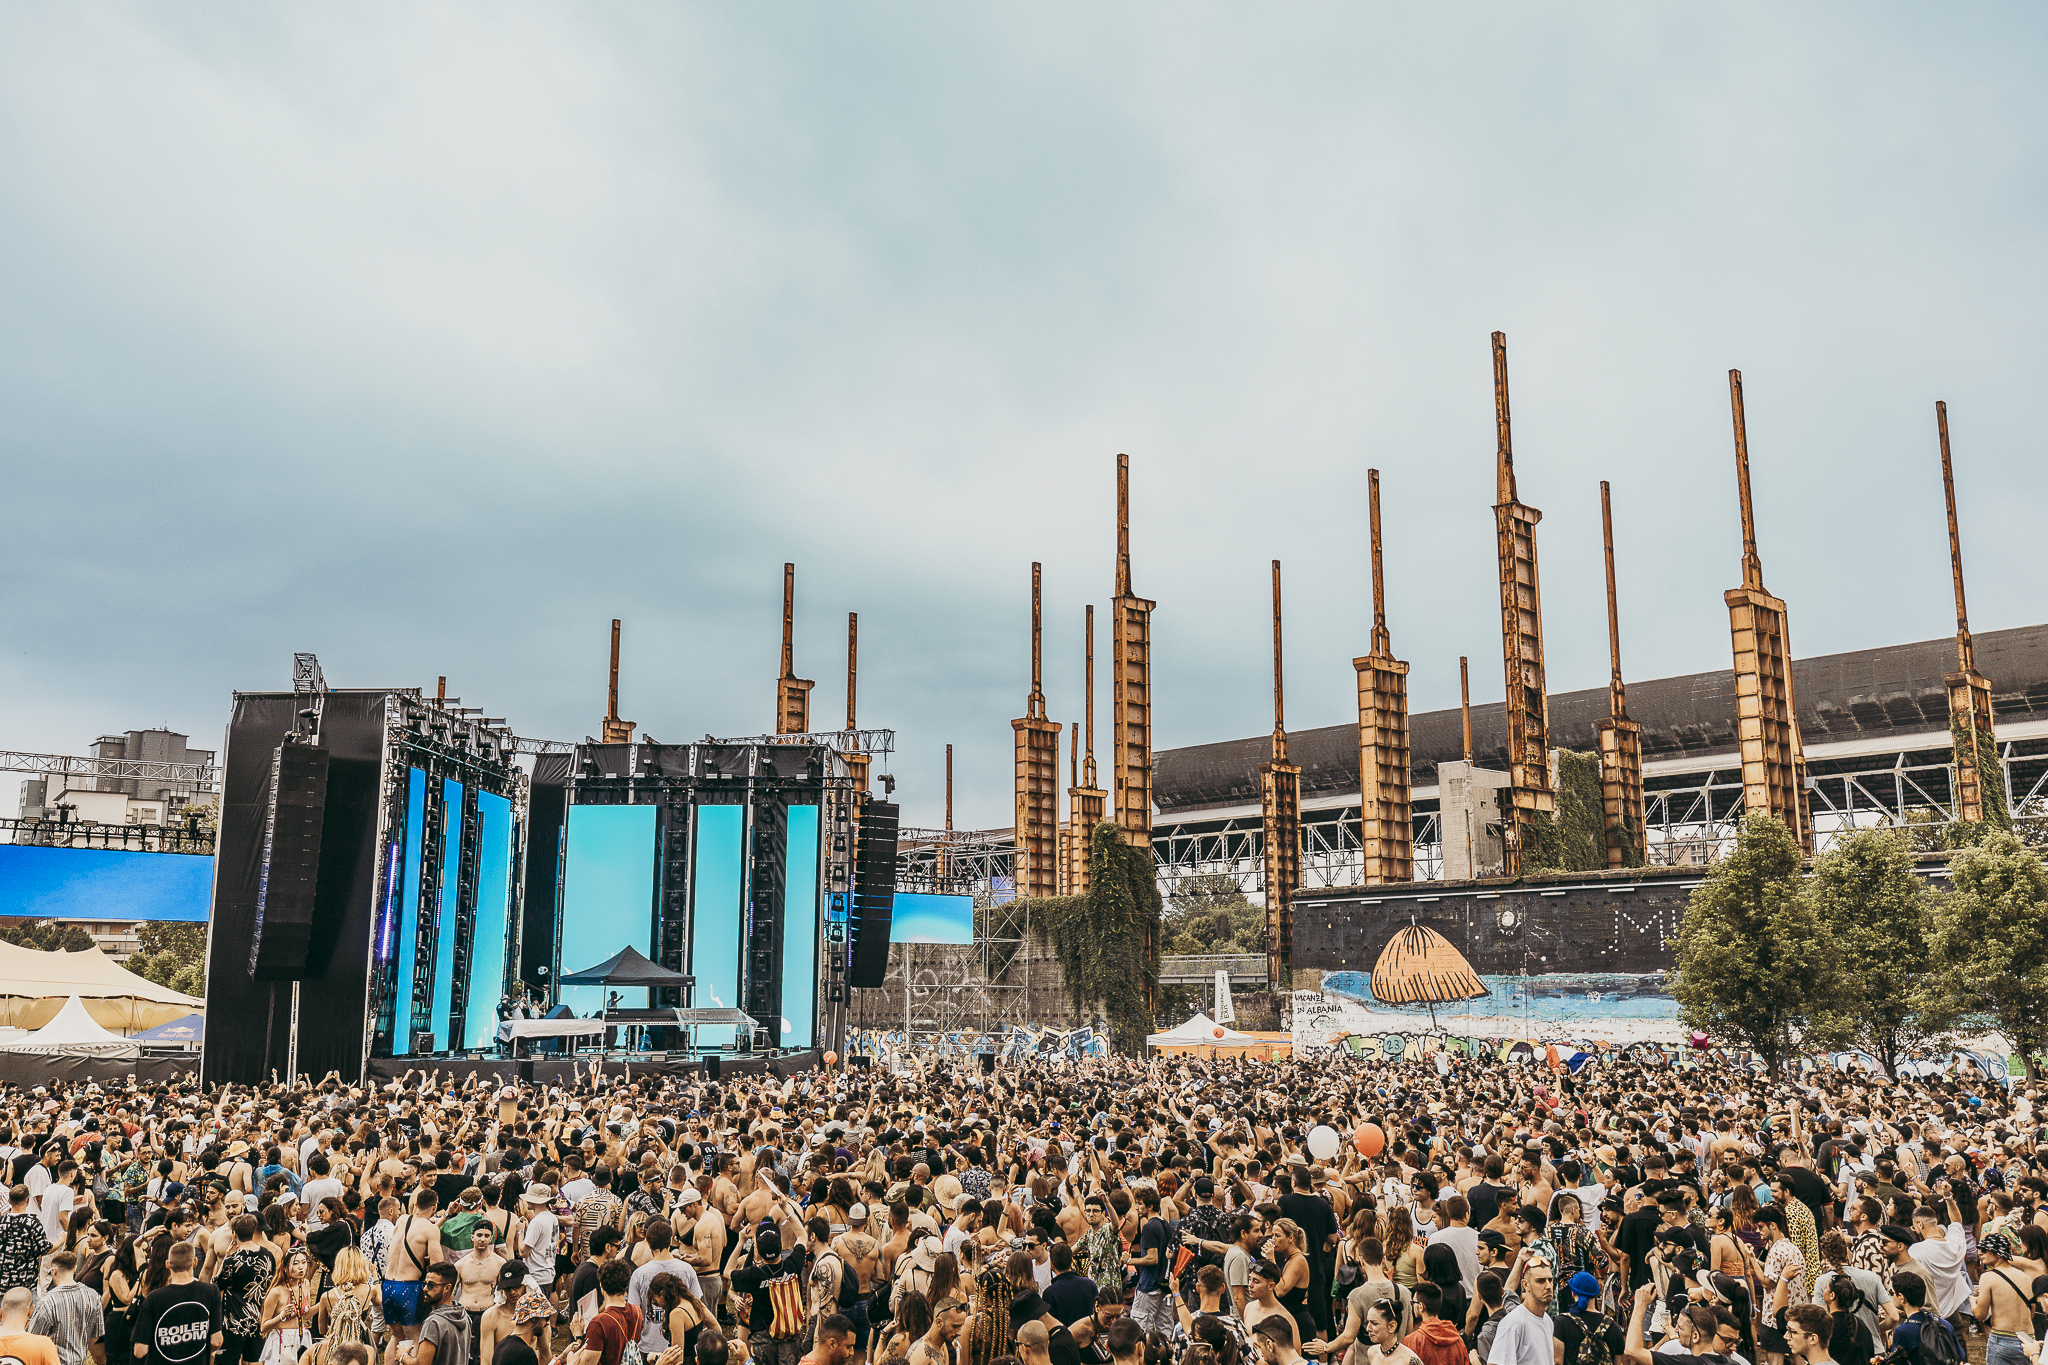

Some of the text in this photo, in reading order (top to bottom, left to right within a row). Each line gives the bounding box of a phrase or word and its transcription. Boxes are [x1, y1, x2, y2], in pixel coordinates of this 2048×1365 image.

[1297, 1006, 1305, 1014] IN
[1386, 1039, 1400, 1051] 23
[1416, 1228, 1427, 1238] WE
[158, 1320, 209, 1338] BOILER
[160, 1329, 207, 1346] ROOM
